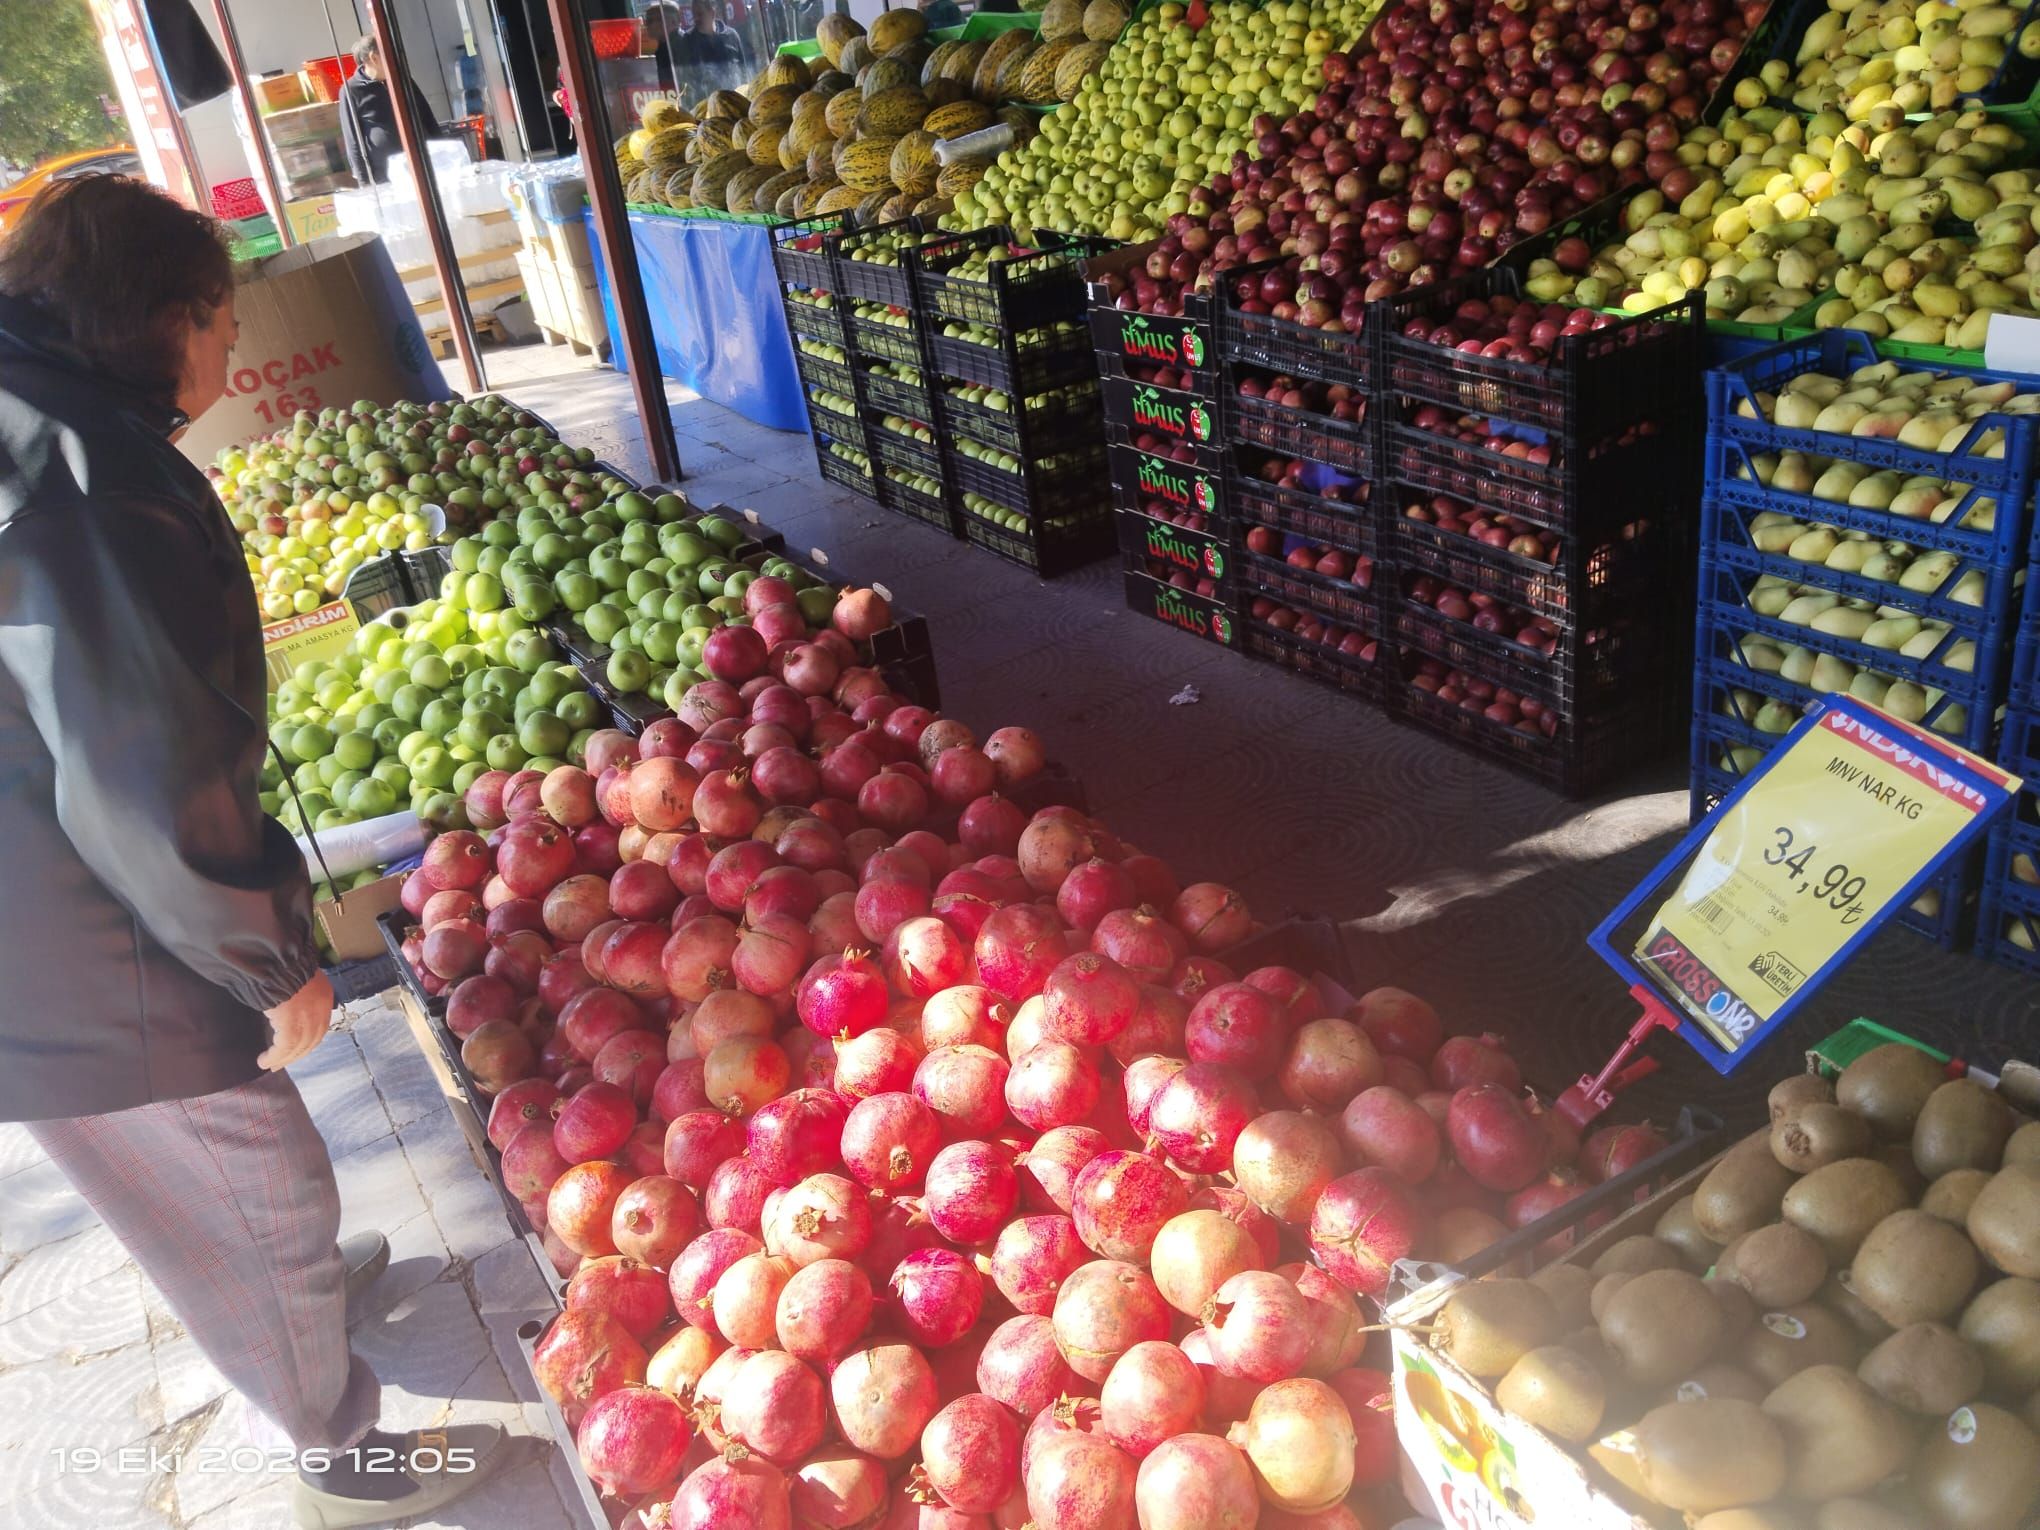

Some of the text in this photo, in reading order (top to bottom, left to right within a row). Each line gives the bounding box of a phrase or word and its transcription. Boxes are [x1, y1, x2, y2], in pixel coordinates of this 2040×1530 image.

[254, 386, 321, 425] 163
[305, 629, 339, 647] AMASYA
[340, 624, 354, 635] KG
[1825, 756, 1923, 820] MNV NAR KG
[1766, 967, 1794, 995] ÜRETİM
[1775, 960, 1799, 982] YERLİ
